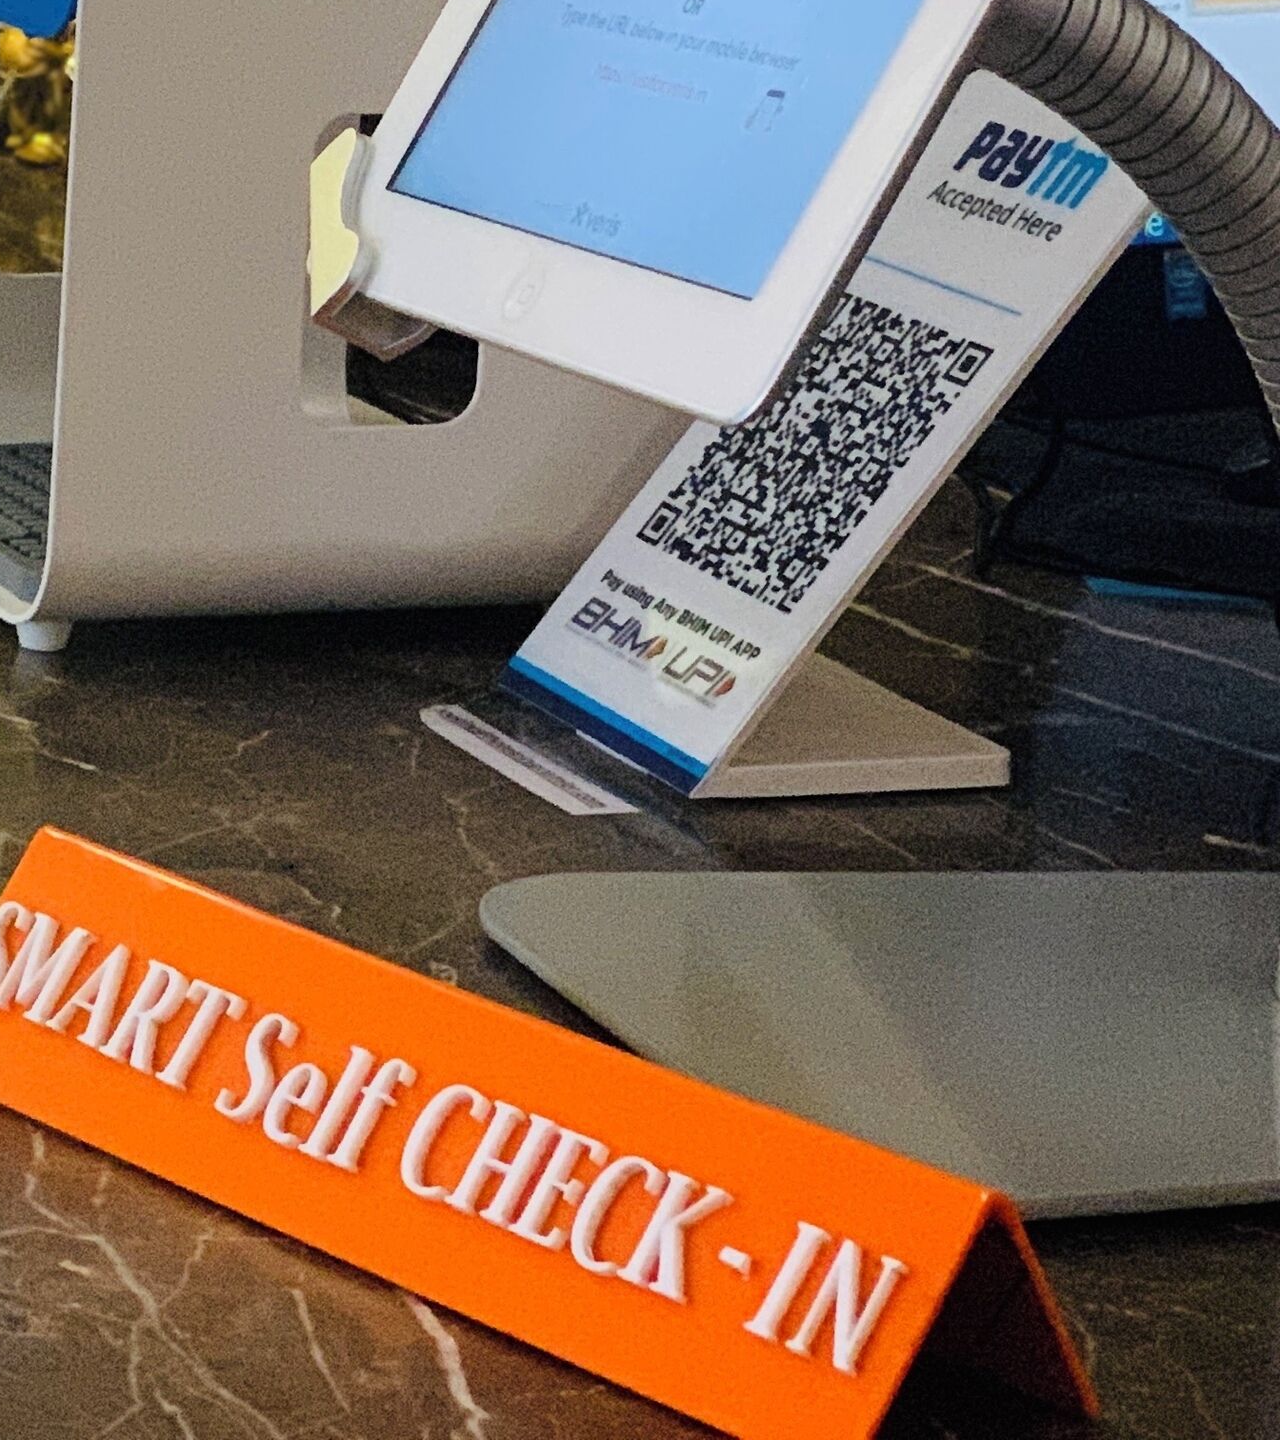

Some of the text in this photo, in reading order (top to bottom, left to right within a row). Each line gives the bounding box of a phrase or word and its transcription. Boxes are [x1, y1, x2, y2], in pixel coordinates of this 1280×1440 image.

[926, 179, 1063, 243] Accepted Here
[571, 596, 662, 658] BHIM
[600, 568, 762, 662] Pay using Any BHIM UPI APP
[662, 645, 732, 697] UPI
[213, 1011, 418, 1175] Self
